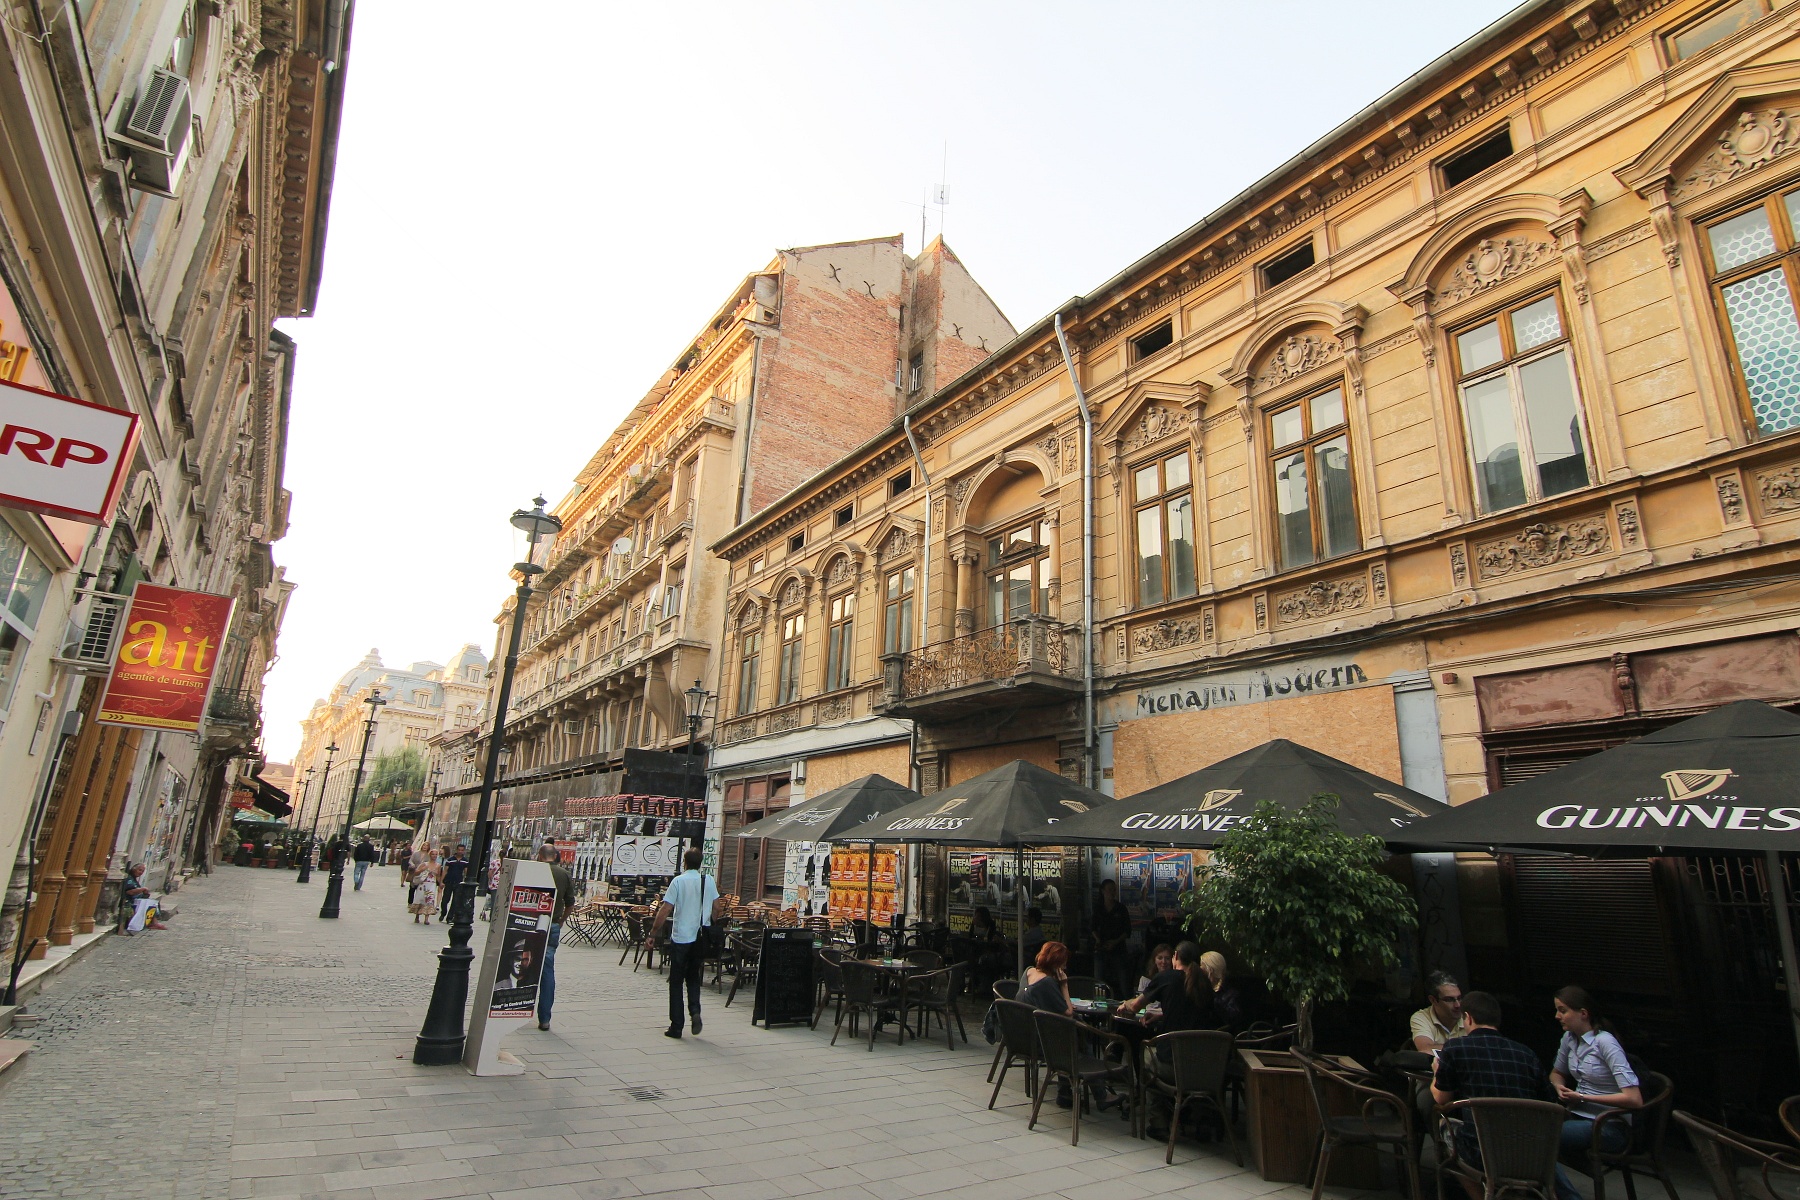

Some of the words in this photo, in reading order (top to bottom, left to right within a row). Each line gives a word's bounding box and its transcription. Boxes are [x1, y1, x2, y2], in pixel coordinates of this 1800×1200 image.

[119, 620, 215, 673] ait
[117, 670, 155, 682] agentie
[157, 675, 170, 683] de
[172, 678, 204, 689] turism
[1248, 662, 1369, 700] Modern
[886, 816, 971, 831] GUINNESS
[950, 858, 971, 867] STEFA
[1033, 860, 1062, 869] STEFAN
[1120, 862, 1141, 870] LACUL
[1155, 863, 1177, 871] LACUL
[1033, 868, 1062, 878] BANICA
